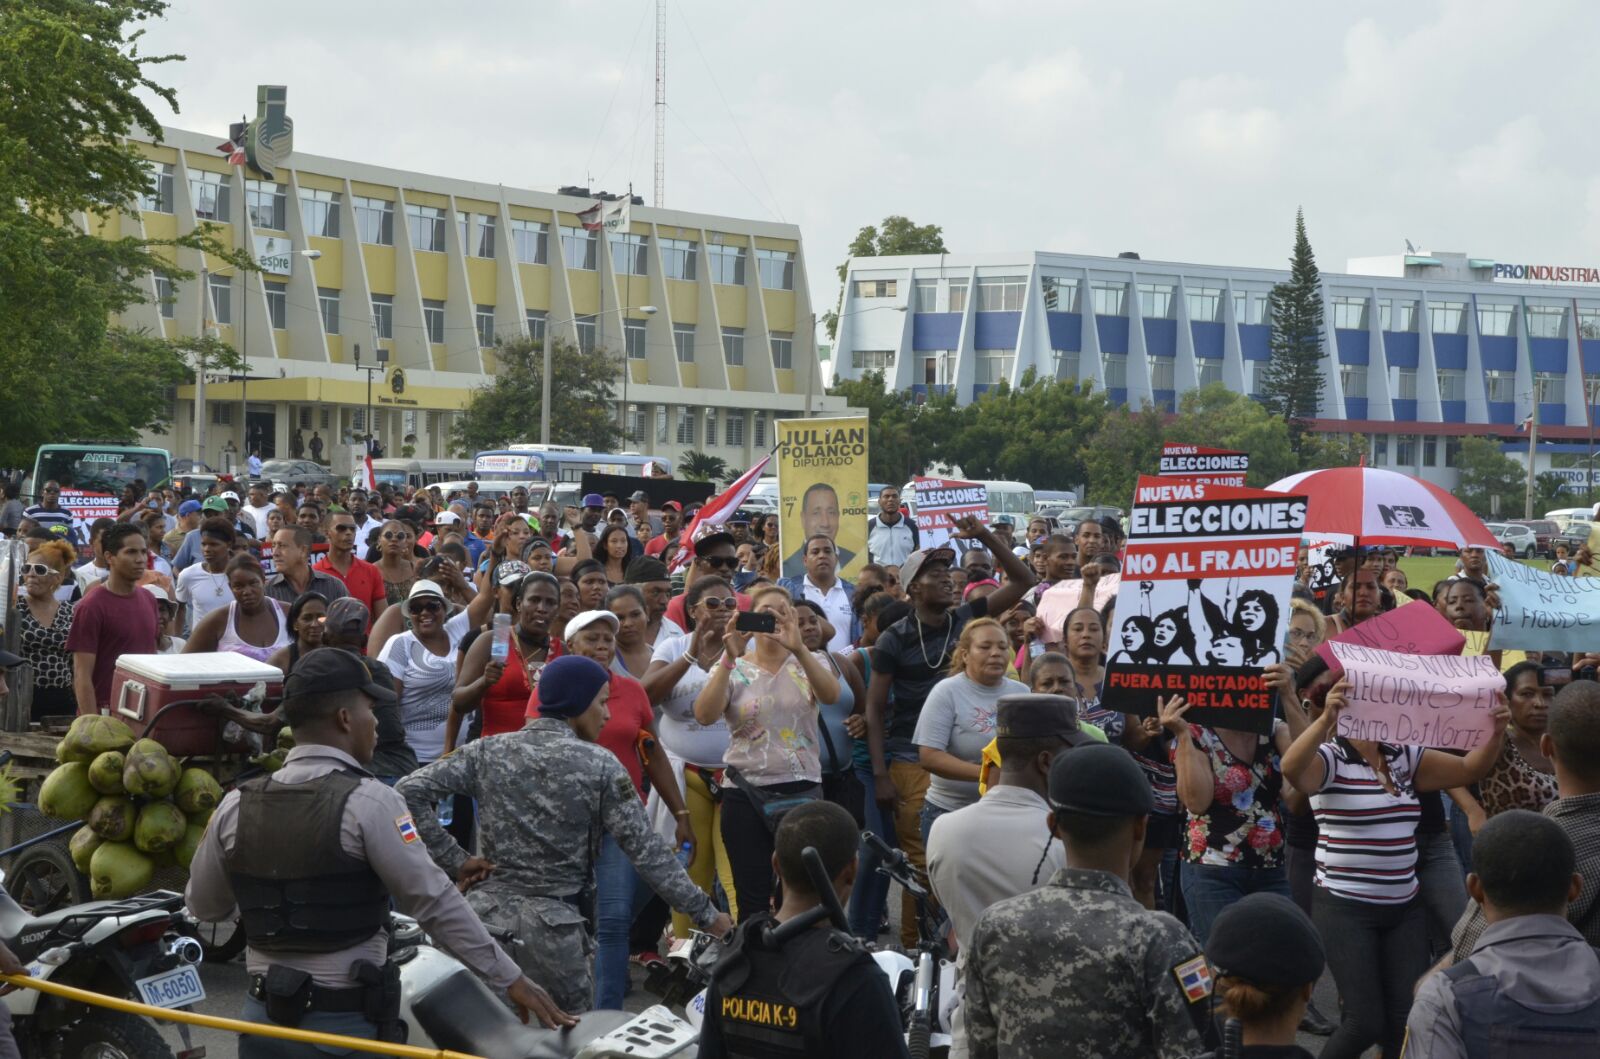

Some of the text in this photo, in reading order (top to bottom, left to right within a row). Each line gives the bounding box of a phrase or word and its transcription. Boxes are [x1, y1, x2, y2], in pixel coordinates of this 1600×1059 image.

[1494, 263, 1600, 283] PROINDUSTRIA
[82, 453, 124, 463] AMET
[782, 444, 865, 459] POLANCO
[793, 457, 853, 467] DIPUTADO
[1160, 456, 1249, 470] ELECCIONES
[915, 480, 943, 490] NUEVAS
[1139, 484, 1205, 502] NUEVAS
[58, 497, 119, 505] ELECCIONES
[915, 488, 987, 505] ELECCIONES
[786, 503, 794, 518] 7
[1131, 502, 1306, 534] ELECCIONES
[919, 515, 932, 527] NO
[935, 514, 948, 525] AL
[1126, 546, 1295, 575] NO AL FRAUDE
[1110, 673, 1163, 689] FUERA
[1167, 674, 1185, 689] EL
[1187, 692, 1269, 708] DE LA JCE
[150, 975, 197, 1003] M-6050
[722, 998, 797, 1027] POLICIA K-9
